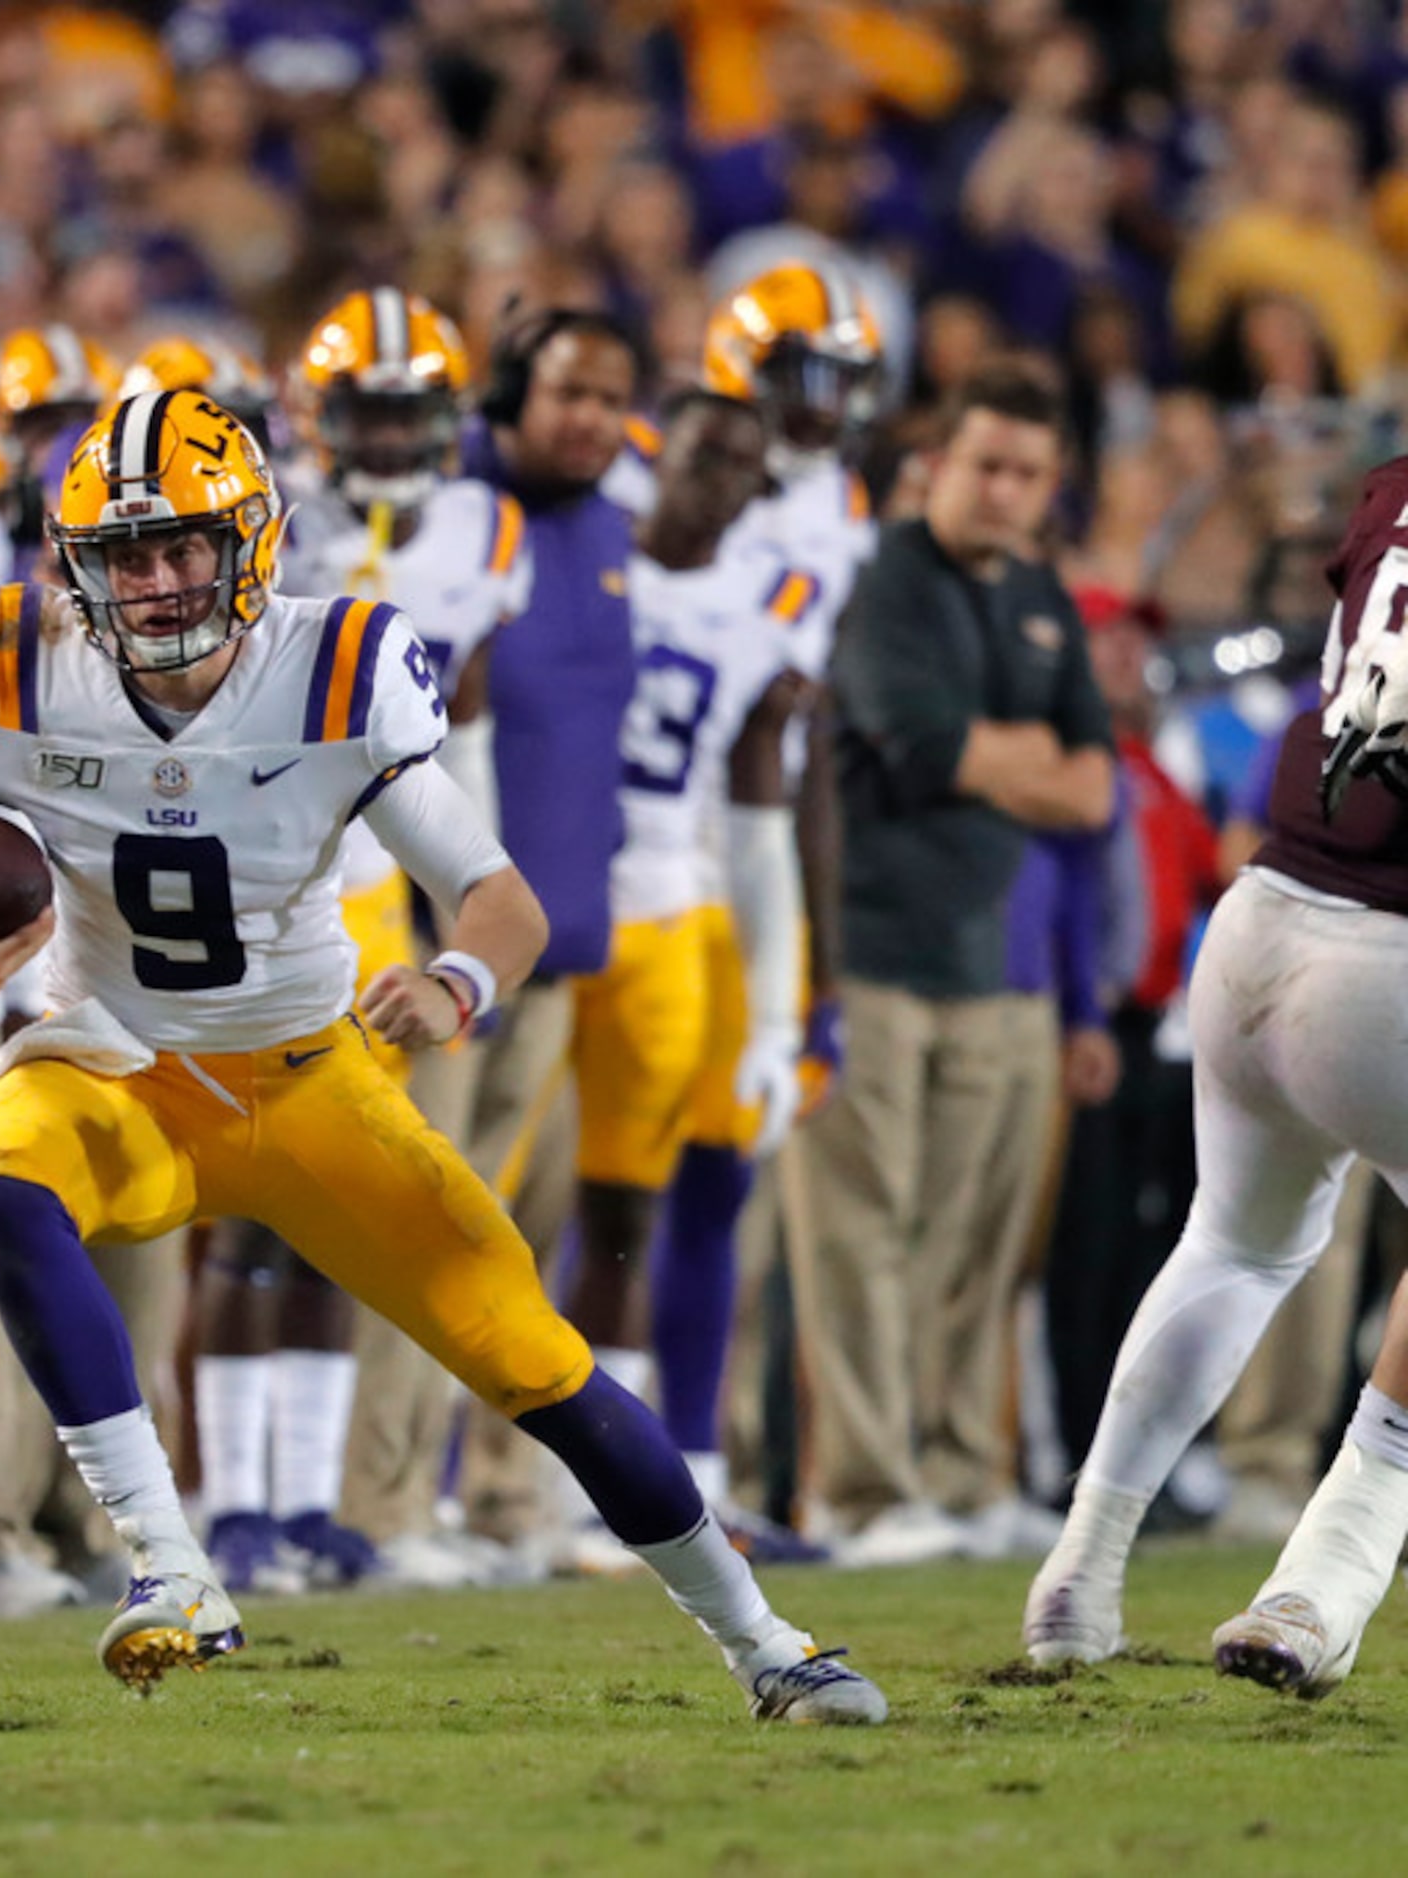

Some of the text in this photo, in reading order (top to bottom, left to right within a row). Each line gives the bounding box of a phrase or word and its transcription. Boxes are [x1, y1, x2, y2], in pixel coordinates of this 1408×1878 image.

[114, 500, 152, 518] LSU
[39, 753, 104, 790] 150
[145, 808, 197, 828] LSU
[112, 832, 247, 992] 9
